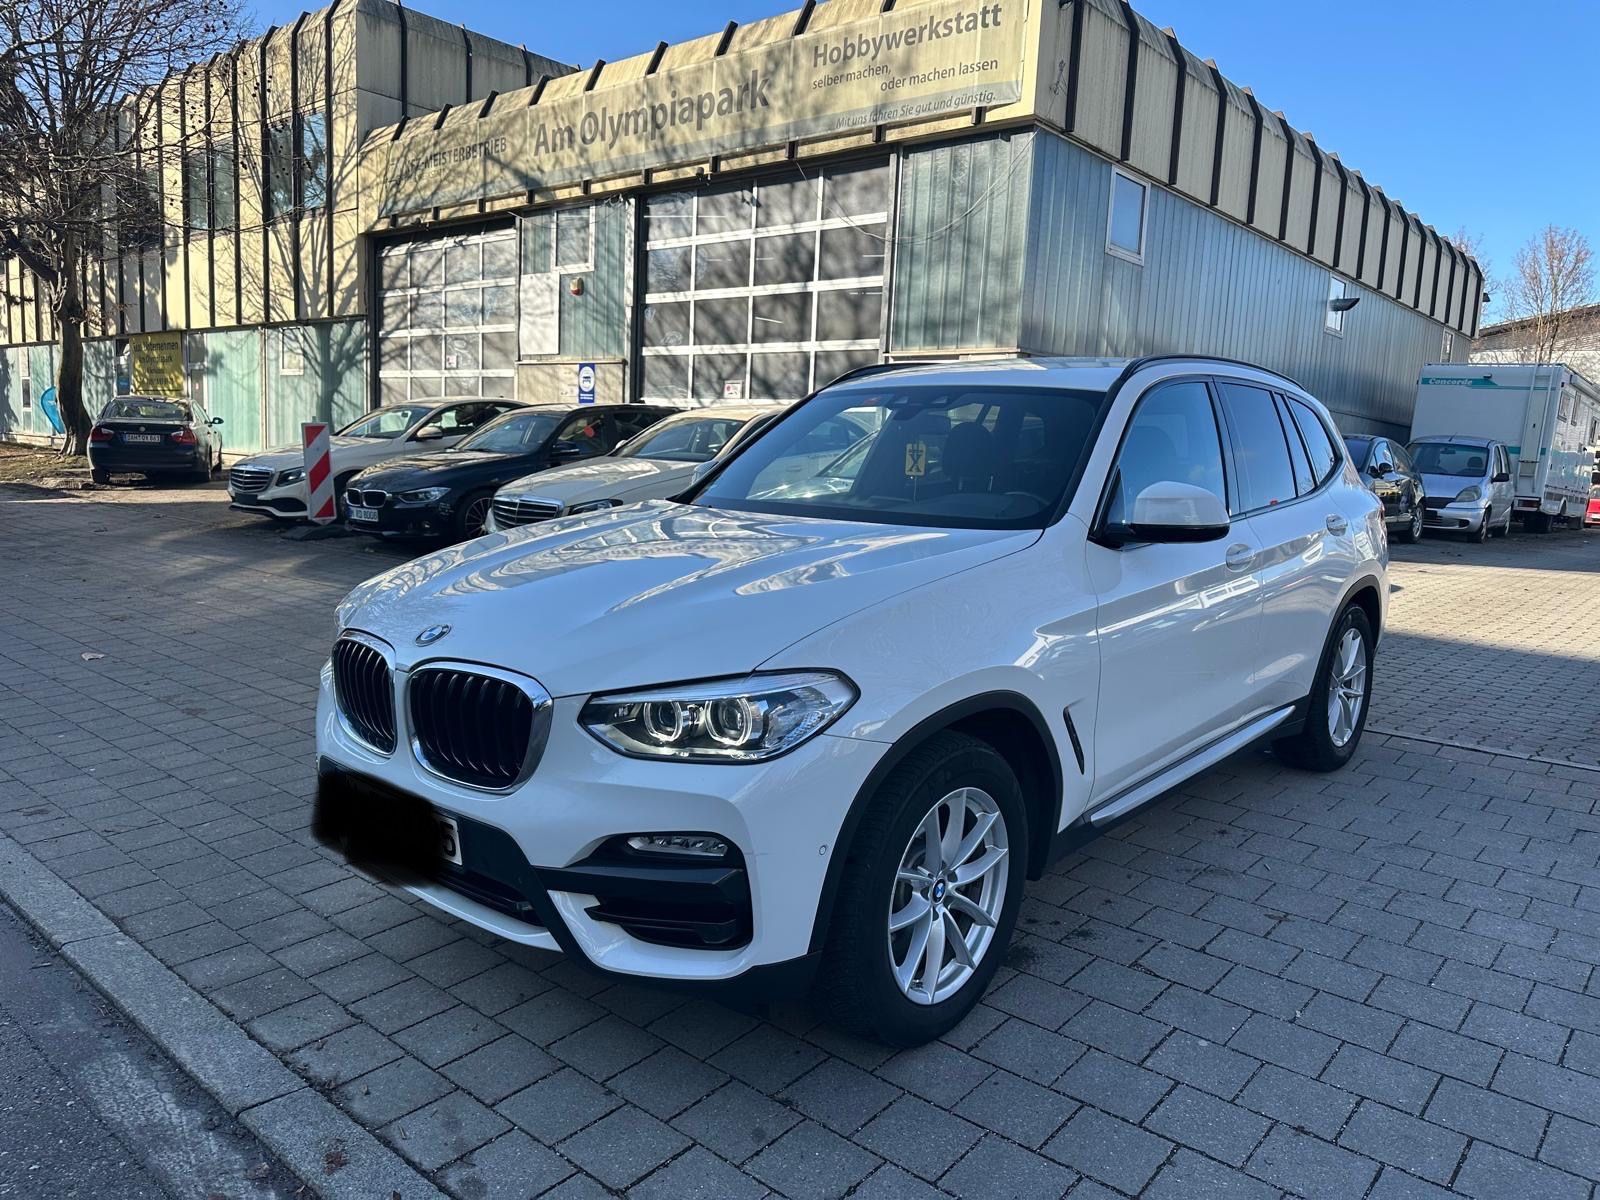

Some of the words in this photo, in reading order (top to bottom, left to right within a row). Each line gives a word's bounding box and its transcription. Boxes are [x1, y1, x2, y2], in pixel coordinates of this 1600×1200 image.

[812, 3, 1002, 68] Hobbywerkstatt
[812, 74, 844, 90] selber
[846, 64, 892, 82] machen,
[880, 77, 906, 92] oder
[909, 66, 955, 87] machen
[958, 58, 998, 76] lassen
[533, 123, 575, 156] Am
[579, 69, 770, 149] Olympiapark
[835, 117, 851, 129] Mit
[852, 113, 869, 126] uns
[868, 107, 898, 126] fahren
[900, 103, 914, 118] Sie
[915, 101, 932, 117] gut
[933, 96, 953, 112] und
[953, 89, 997, 109] günstig.
[1428, 378, 1473, 386] Concorde
